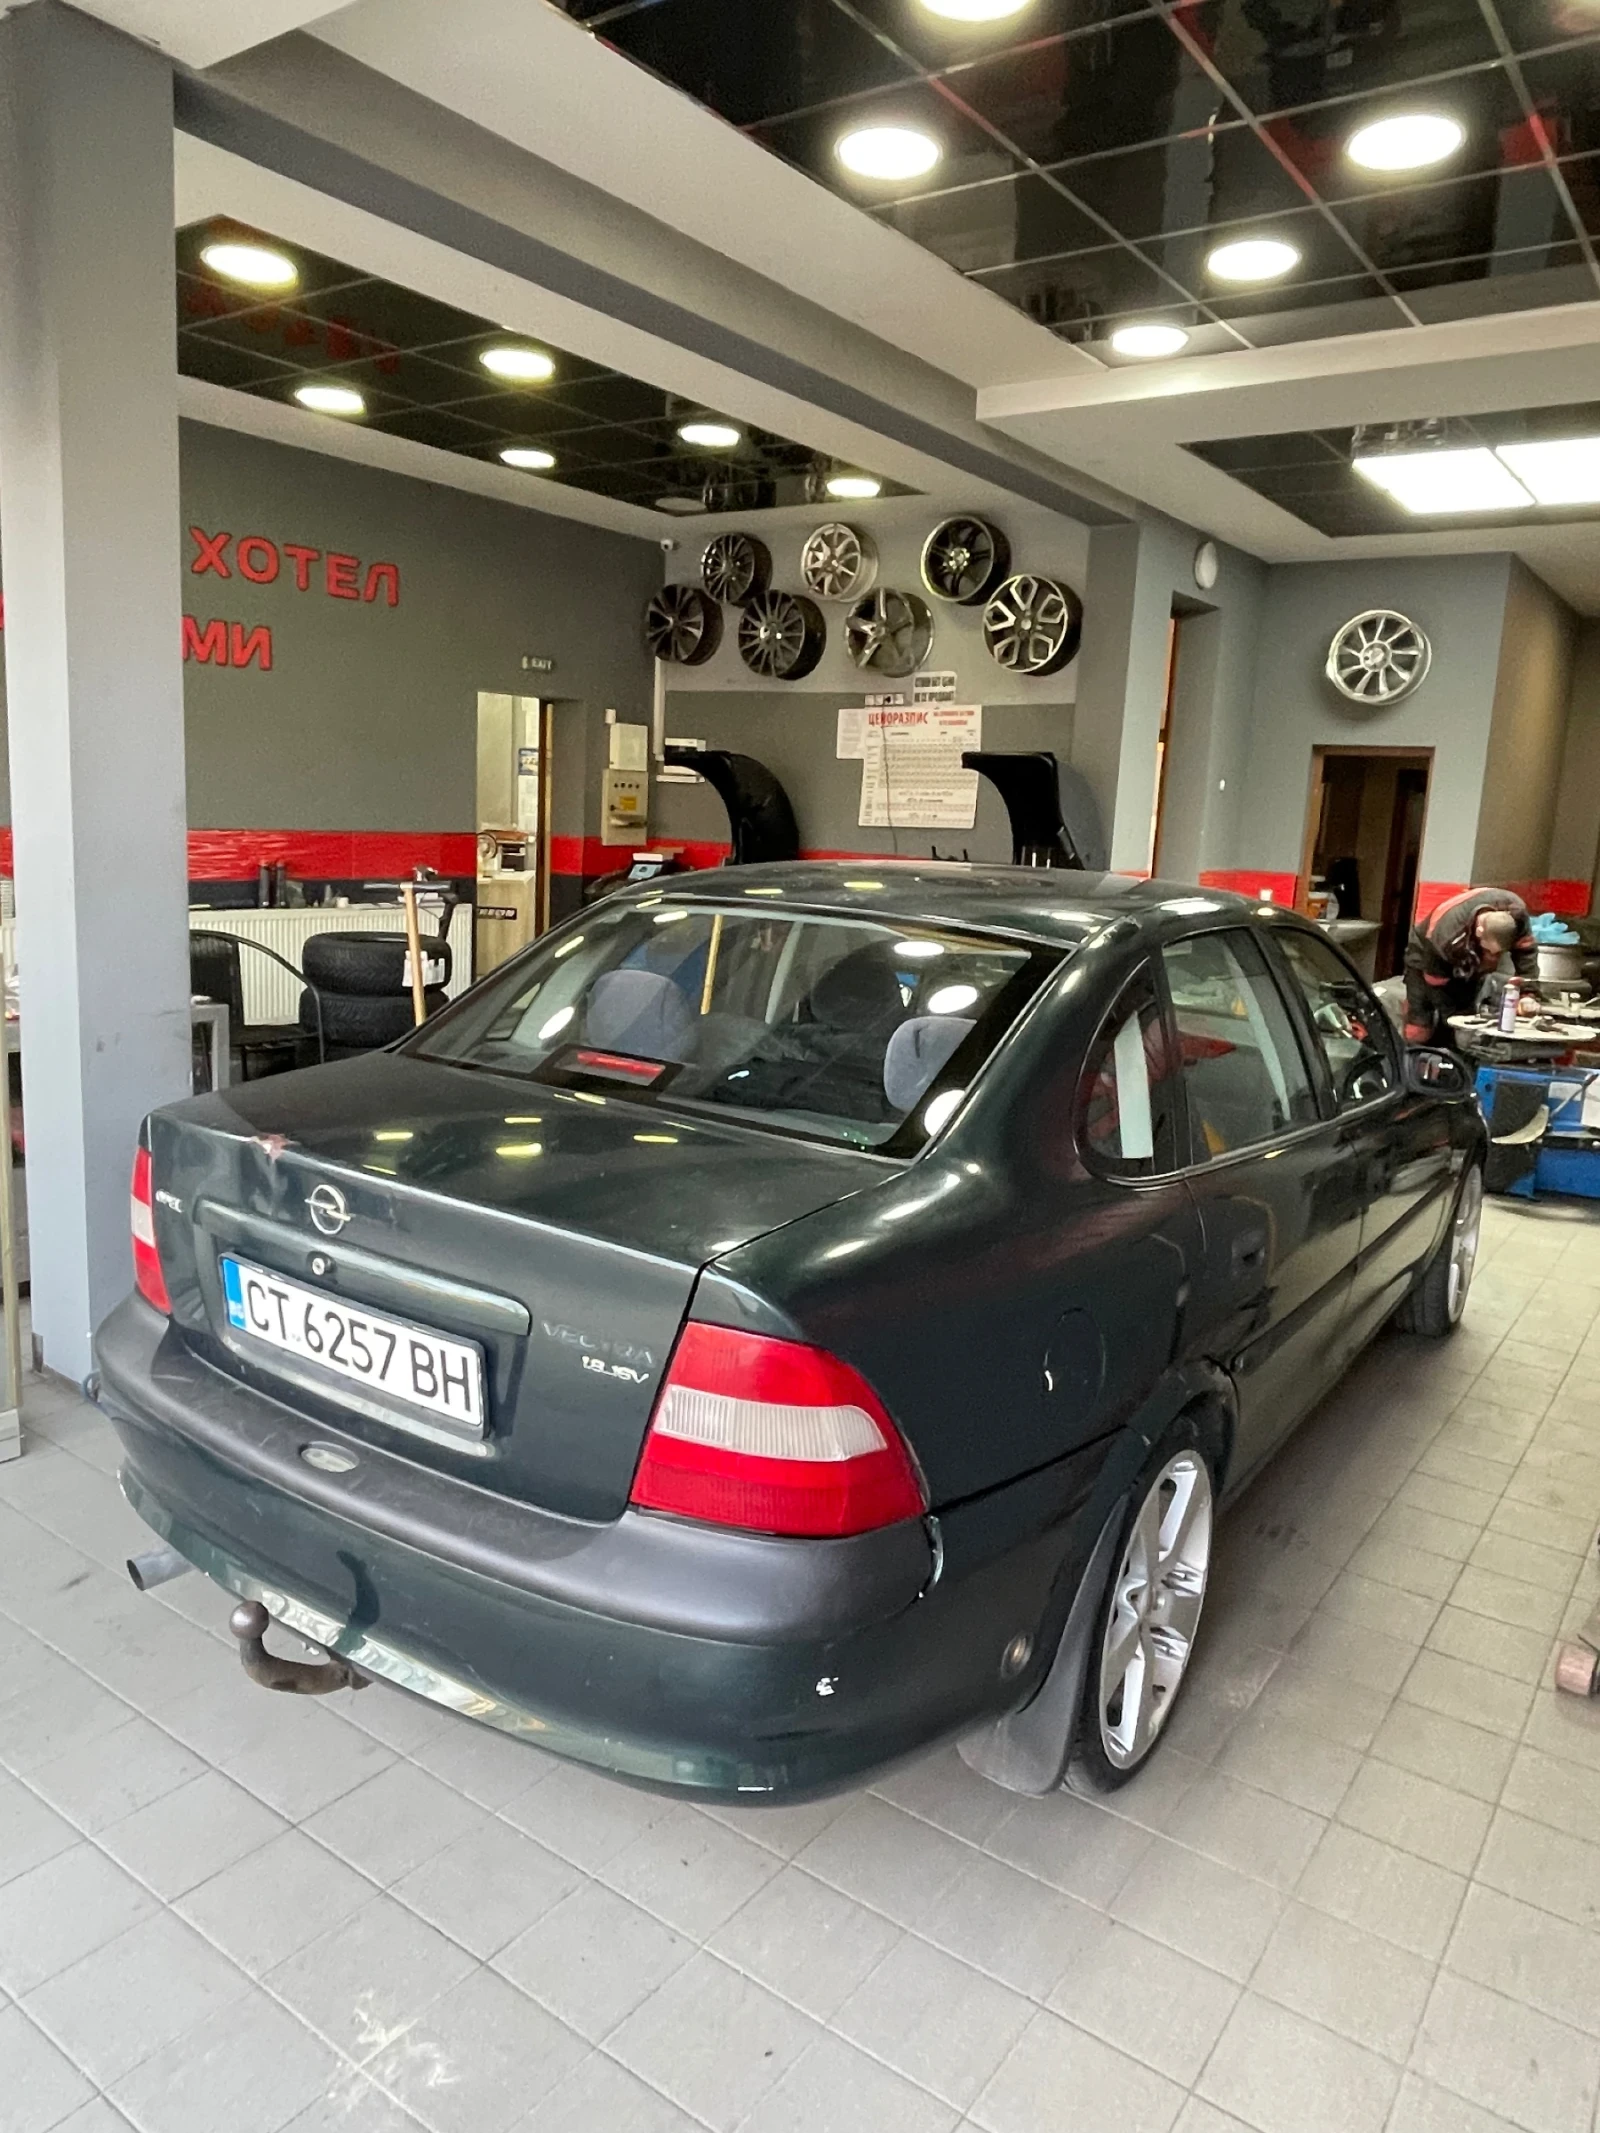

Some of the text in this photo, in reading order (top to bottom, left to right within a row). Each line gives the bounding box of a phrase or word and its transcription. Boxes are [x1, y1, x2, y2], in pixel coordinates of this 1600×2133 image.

[189, 526, 399, 607] ХОТЕЛ
[247, 1279, 471, 1412] CT 6257 BH
